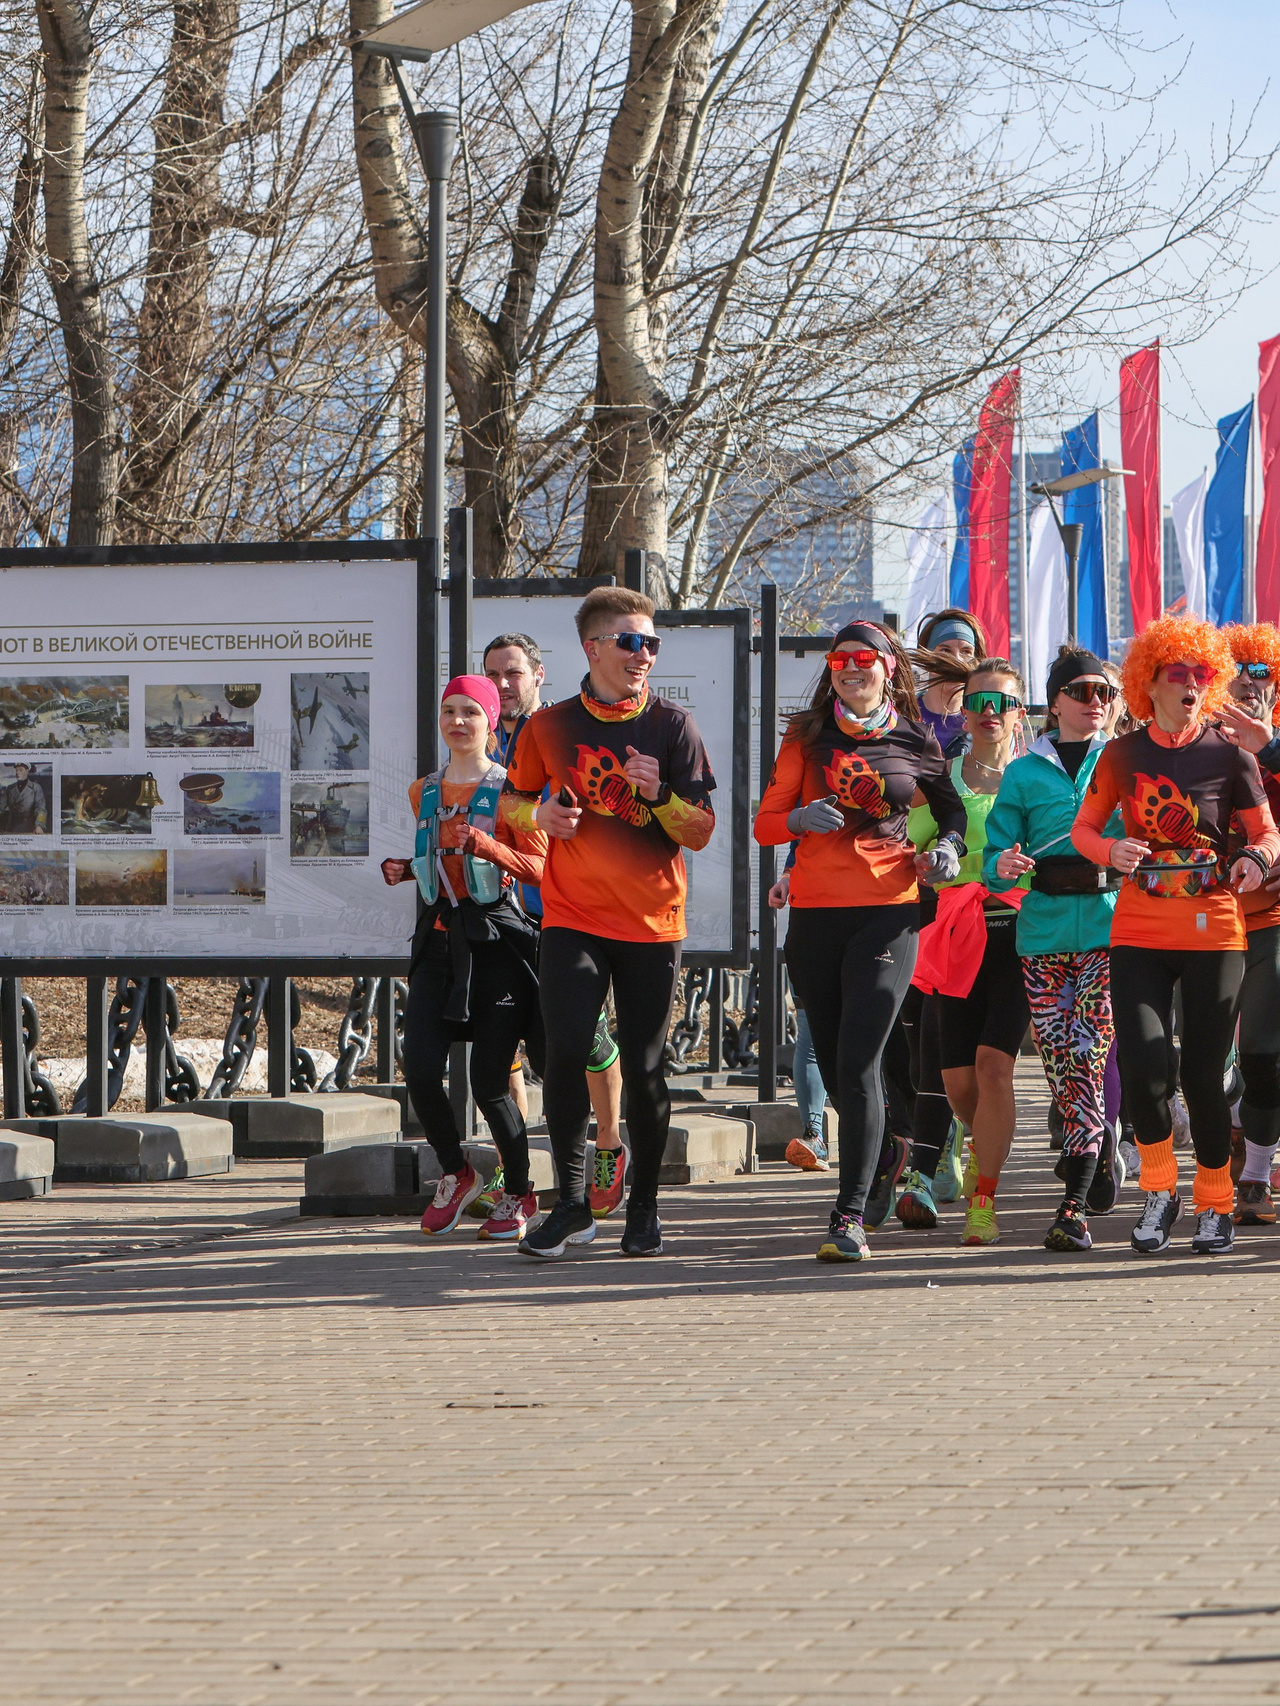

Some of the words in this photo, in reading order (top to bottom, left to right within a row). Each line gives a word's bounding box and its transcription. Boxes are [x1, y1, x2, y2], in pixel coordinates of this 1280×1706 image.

[0, 637, 28, 653] ОТ
[33, 637, 43, 653] В
[49, 632, 138, 652] ВЕЛИКОЙ
[143, 629, 302, 651] ОТЕЧЕСТВЕННОЙ
[308, 629, 373, 649] ВОЙНЕ
[985, 919, 1011, 927] EMIX
